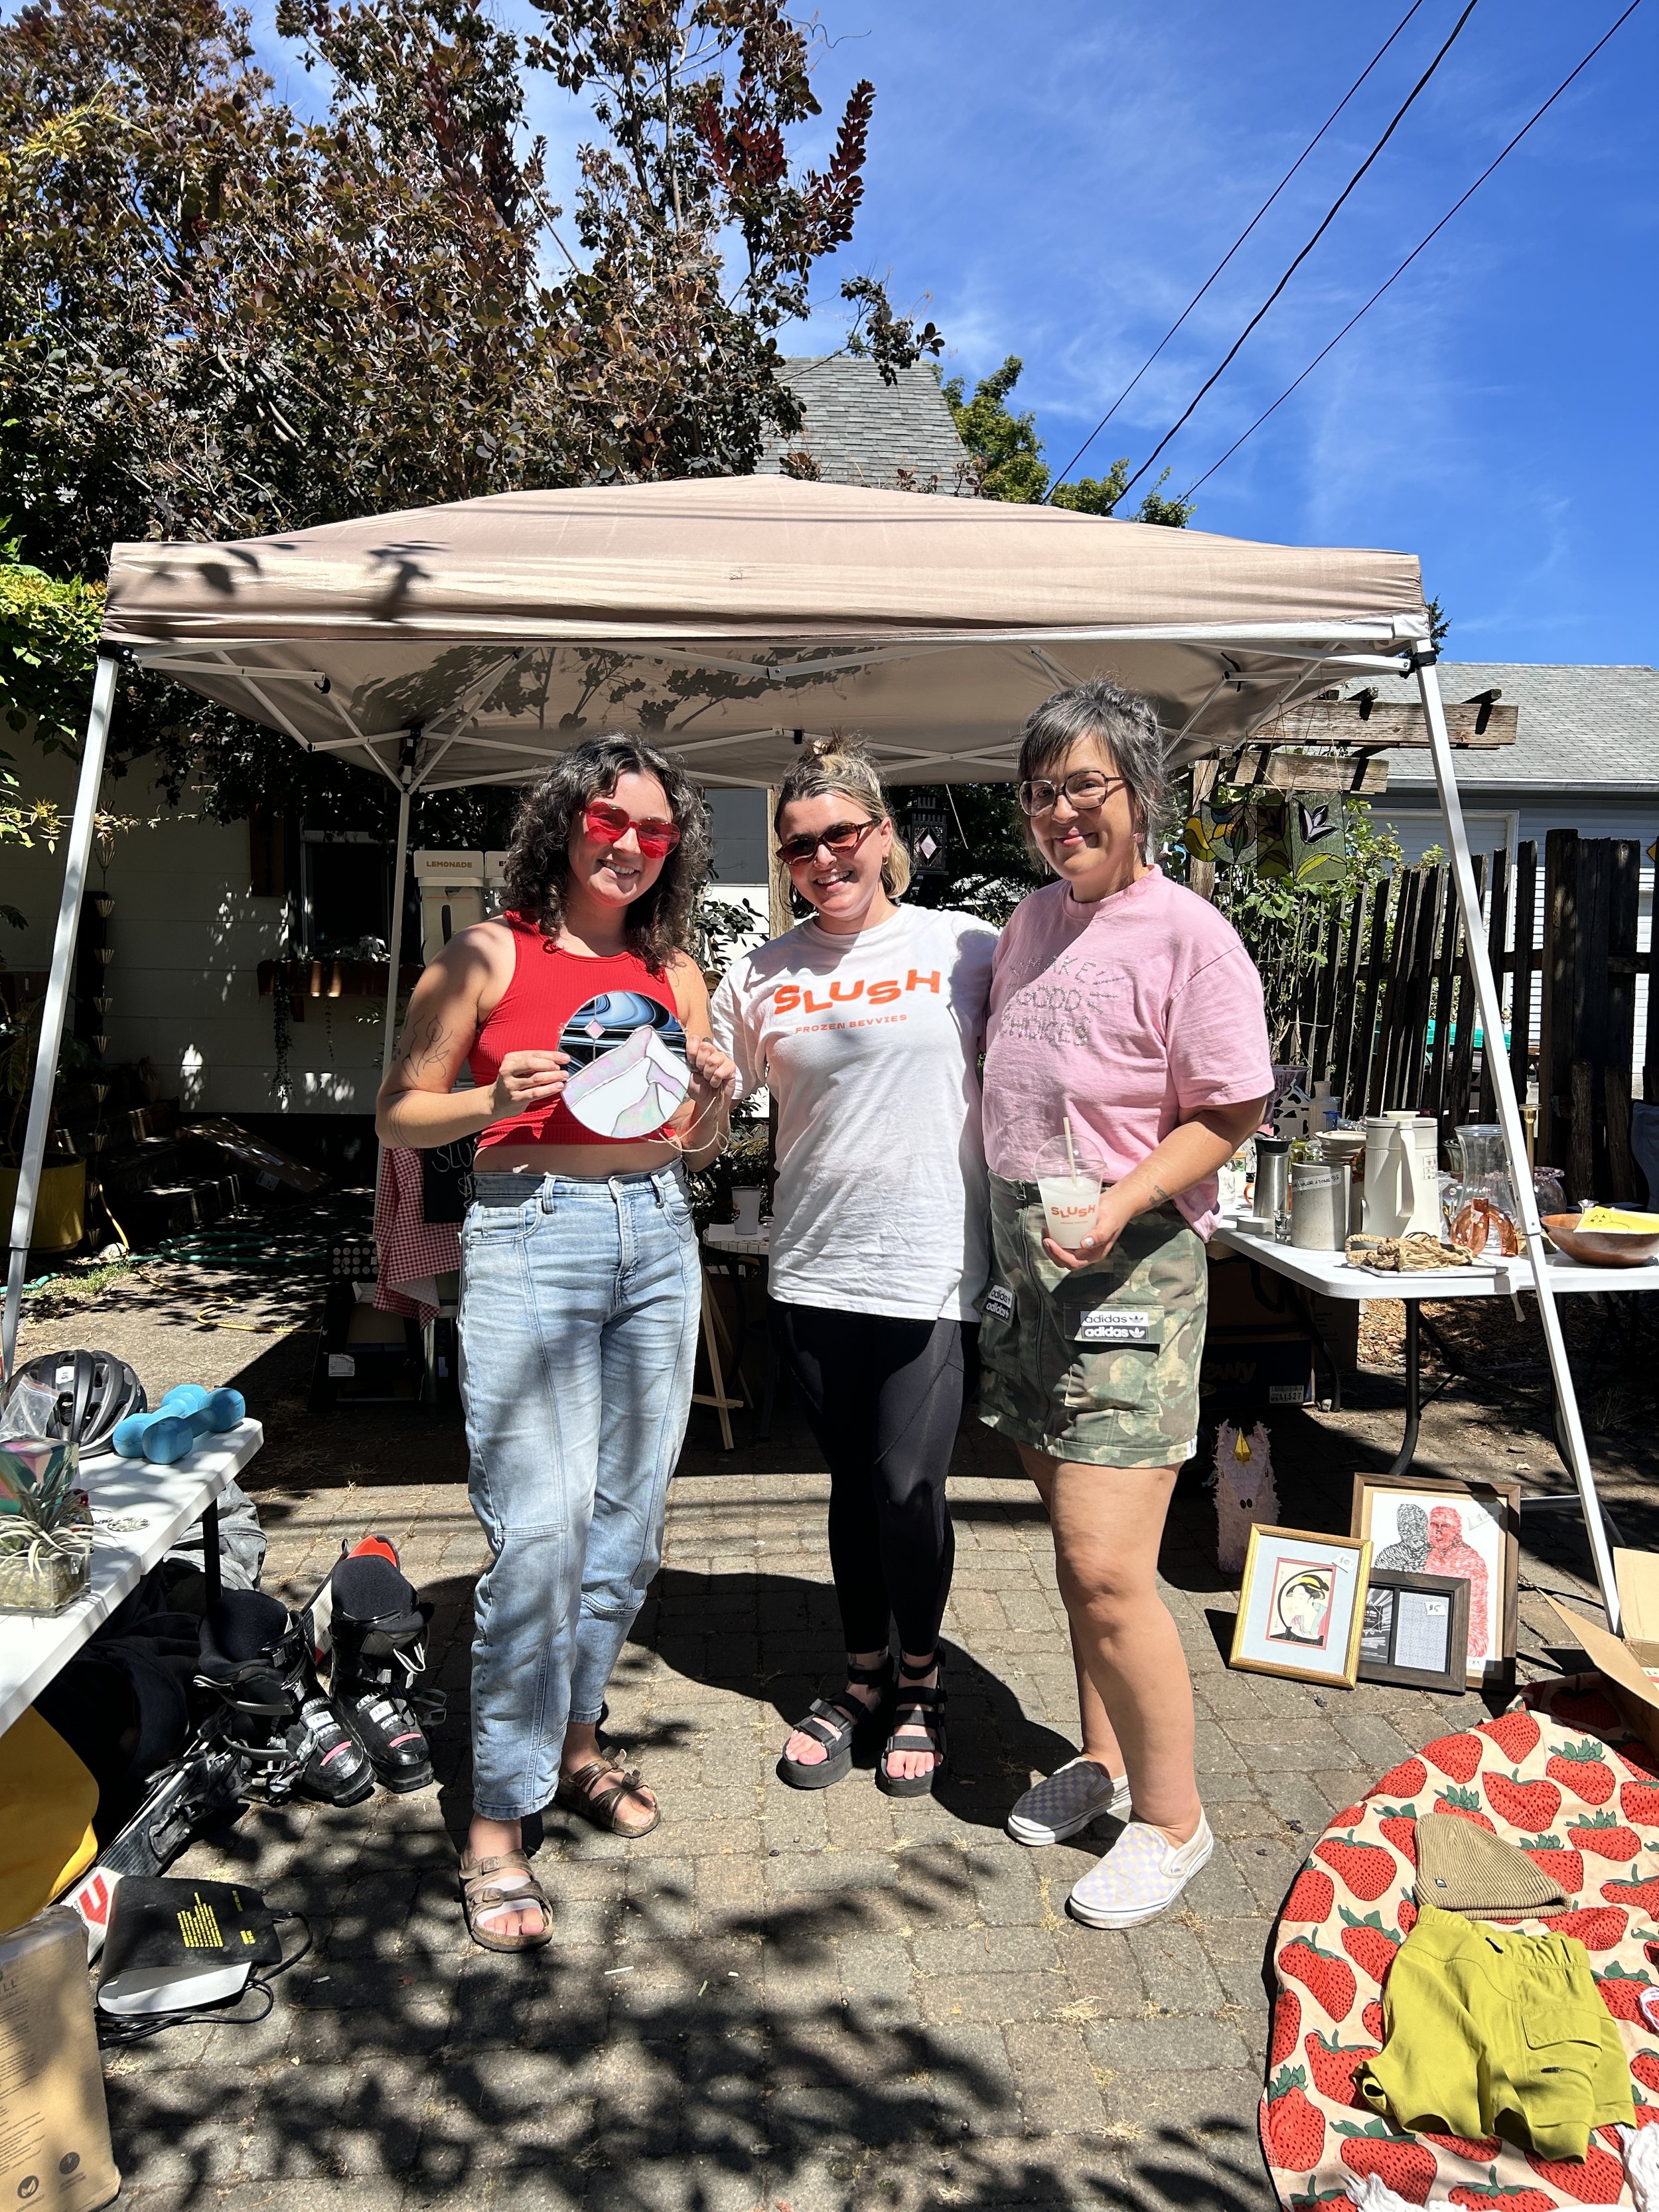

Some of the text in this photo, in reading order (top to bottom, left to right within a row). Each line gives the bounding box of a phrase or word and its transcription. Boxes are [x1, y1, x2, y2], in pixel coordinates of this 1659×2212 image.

[774, 969, 940, 1015] SLUSH
[1015, 984, 1082, 1012] GOOD
[796, 1014, 907, 1034] FROZEN BEVVIES
[432, 1142, 476, 1173] SLU
[1050, 1205, 1096, 1218] SLUSH
[985, 1301, 1006, 1317] adidas
[1084, 1314, 1127, 1323] adidas
[1084, 1327, 1129, 1338] adidas
